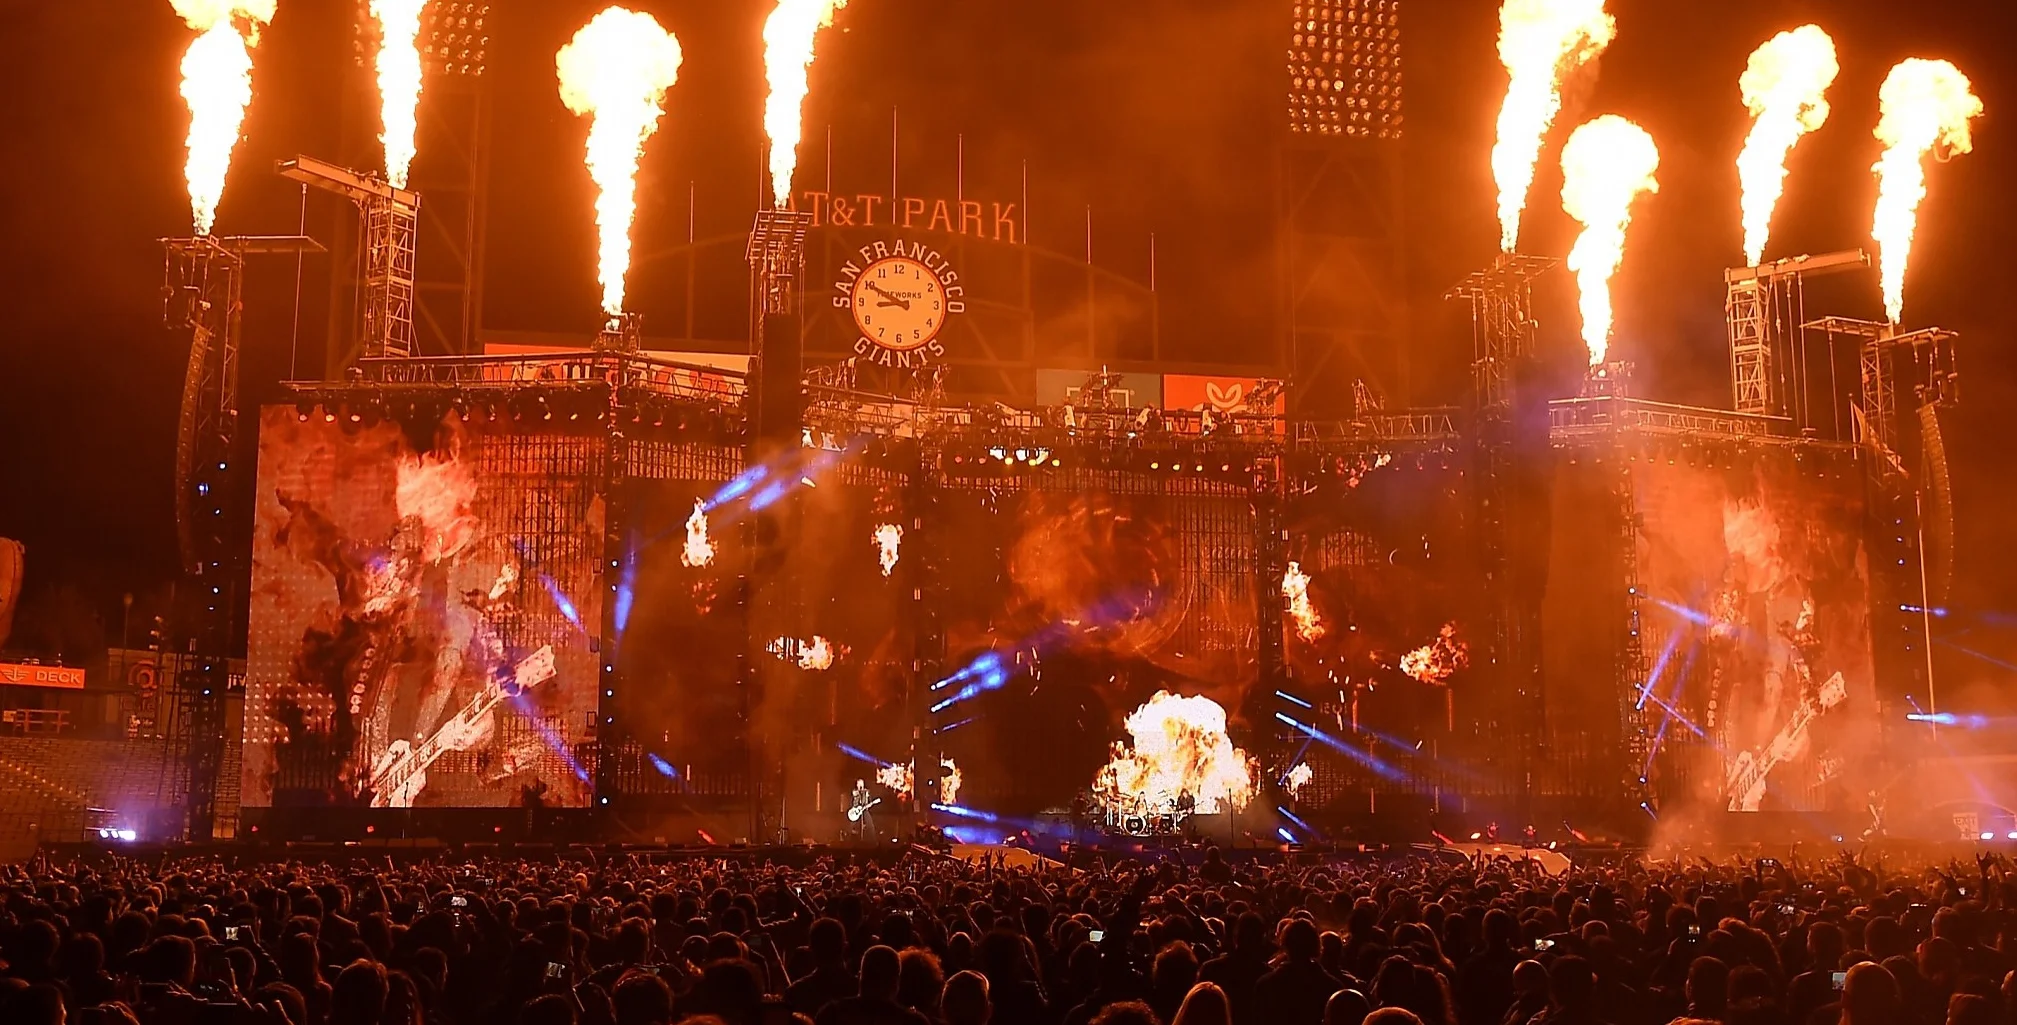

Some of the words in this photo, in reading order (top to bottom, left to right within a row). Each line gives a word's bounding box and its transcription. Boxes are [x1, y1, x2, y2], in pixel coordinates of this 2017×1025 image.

[902, 198, 1017, 244] PARK
[878, 268, 887, 279] 11
[894, 264, 905, 275] 12
[915, 269, 920, 280] 1
[833, 260, 861, 308] SAN
[859, 239, 965, 313] FRANCISCO
[927, 282, 934, 293] 2
[877, 289, 922, 299] EWORKS
[858, 297, 865, 307] 9
[933, 300, 940, 310] 3
[864, 315, 871, 325] 8
[926, 318, 933, 328] 4
[878, 327, 885, 338] 7
[895, 333, 902, 343] 6
[913, 329, 920, 339] 5
[853, 336, 945, 368] GIANTS
[36, 670, 81, 684] DECK
